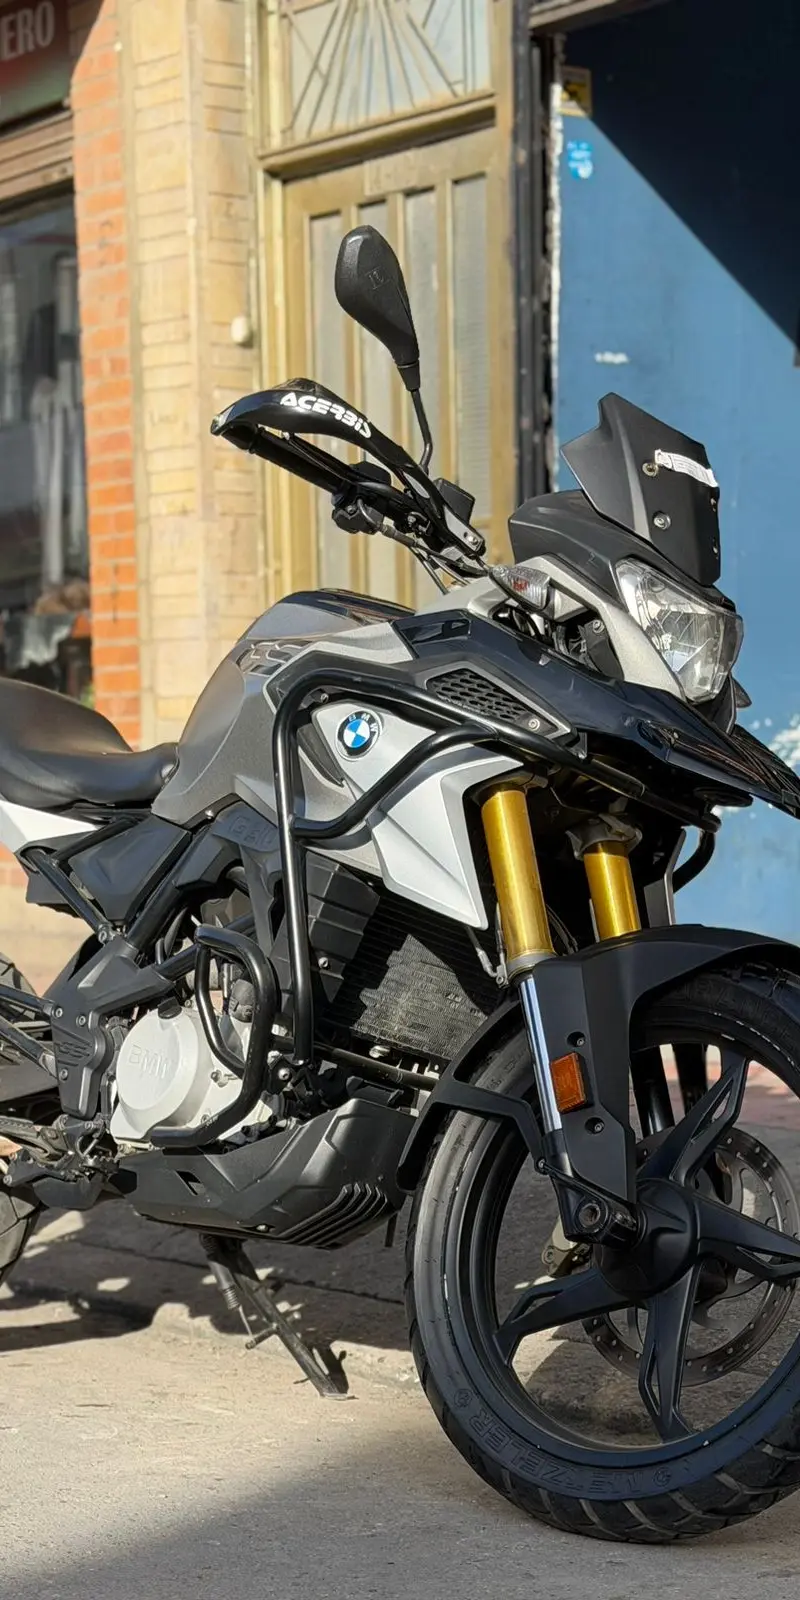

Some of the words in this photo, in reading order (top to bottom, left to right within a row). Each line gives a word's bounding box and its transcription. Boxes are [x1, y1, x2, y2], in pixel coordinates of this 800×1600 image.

[0, 1, 55, 60] ERO
[280, 391, 371, 438] ACERBIS
[349, 712, 378, 732] BMW
[126, 1043, 173, 1079] BMW
[468, 1409, 644, 1494] METZELER
